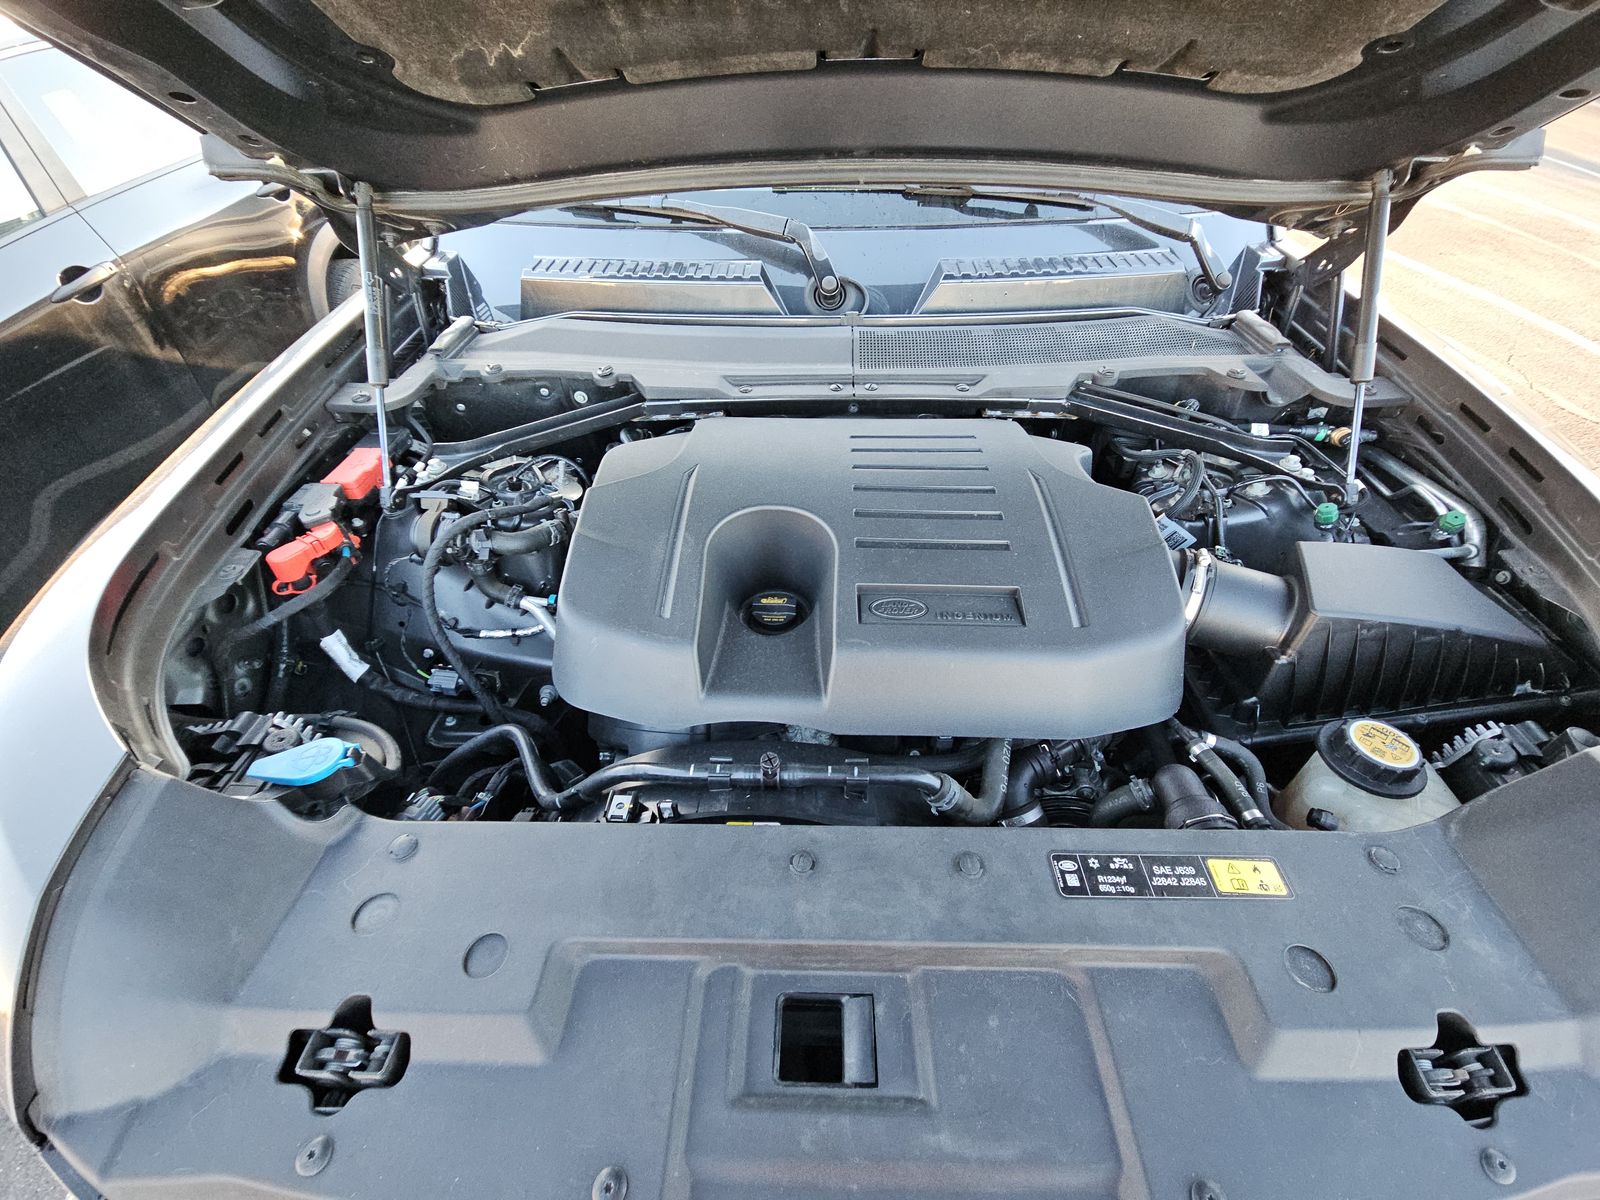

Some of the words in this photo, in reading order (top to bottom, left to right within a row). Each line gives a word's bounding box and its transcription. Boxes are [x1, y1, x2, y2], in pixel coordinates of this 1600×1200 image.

[935, 611, 1016, 621] INGENIUM
[1152, 865, 1173, 875] SAE
[1174, 866, 1196, 875] J639
[1097, 875, 1127, 885] R1234yf
[1151, 877, 1179, 886] J2842
[1180, 877, 1207, 886] J2845
